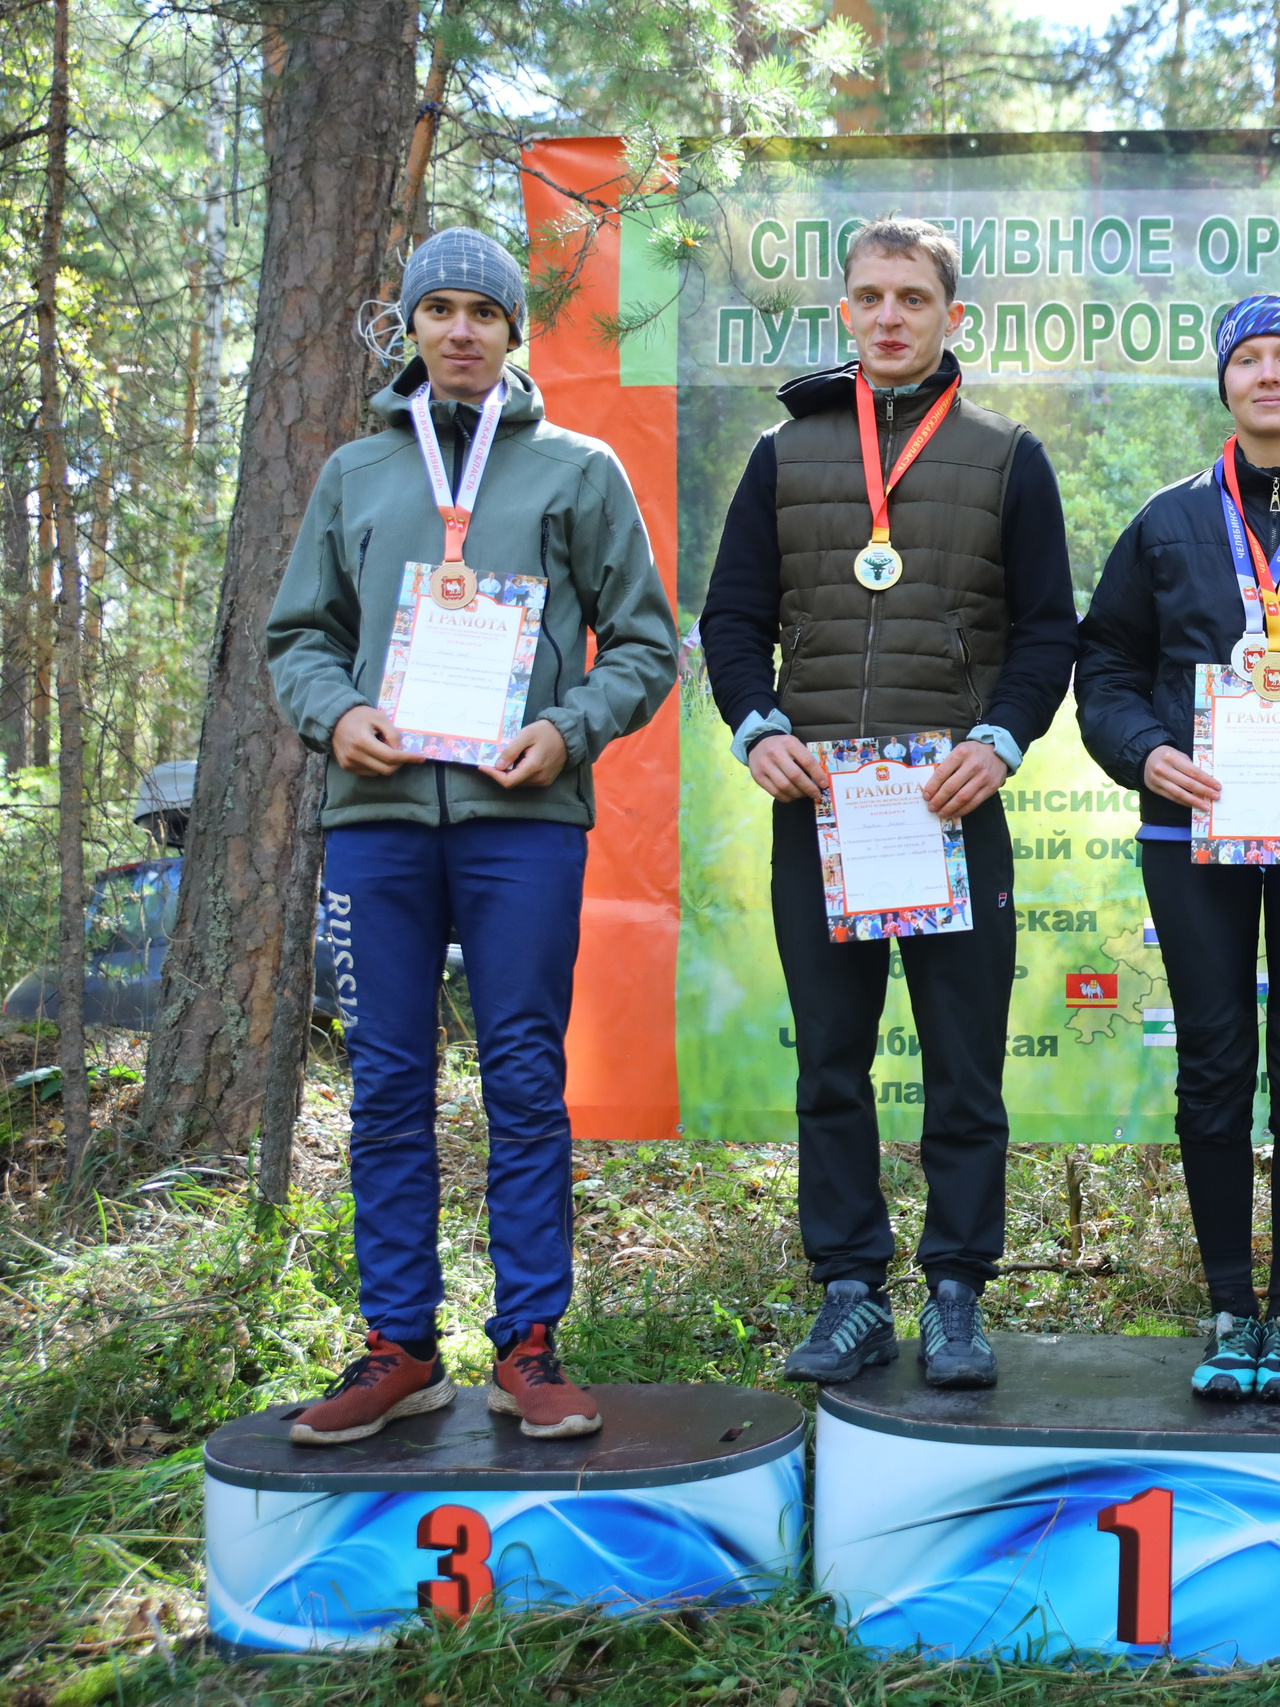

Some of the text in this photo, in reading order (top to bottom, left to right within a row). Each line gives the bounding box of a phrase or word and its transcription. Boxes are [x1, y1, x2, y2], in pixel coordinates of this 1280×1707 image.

[750, 217, 1172, 280] СПИВНОЕ
[420, 420, 444, 489] ЧЕЛЯБИНСКАЯ
[466, 447, 485, 491] ОБЛАСТЬ
[897, 436, 924, 472] ОБЛАСТЬ
[428, 611, 508, 632] ГРАМОТА
[844, 781, 924, 800] ГРАМОТА
[1012, 829, 1073, 861] ый
[328, 890, 359, 1030] RUSSIA
[416, 1504, 495, 1627] 3
[1097, 1487, 1174, 1645] 1
